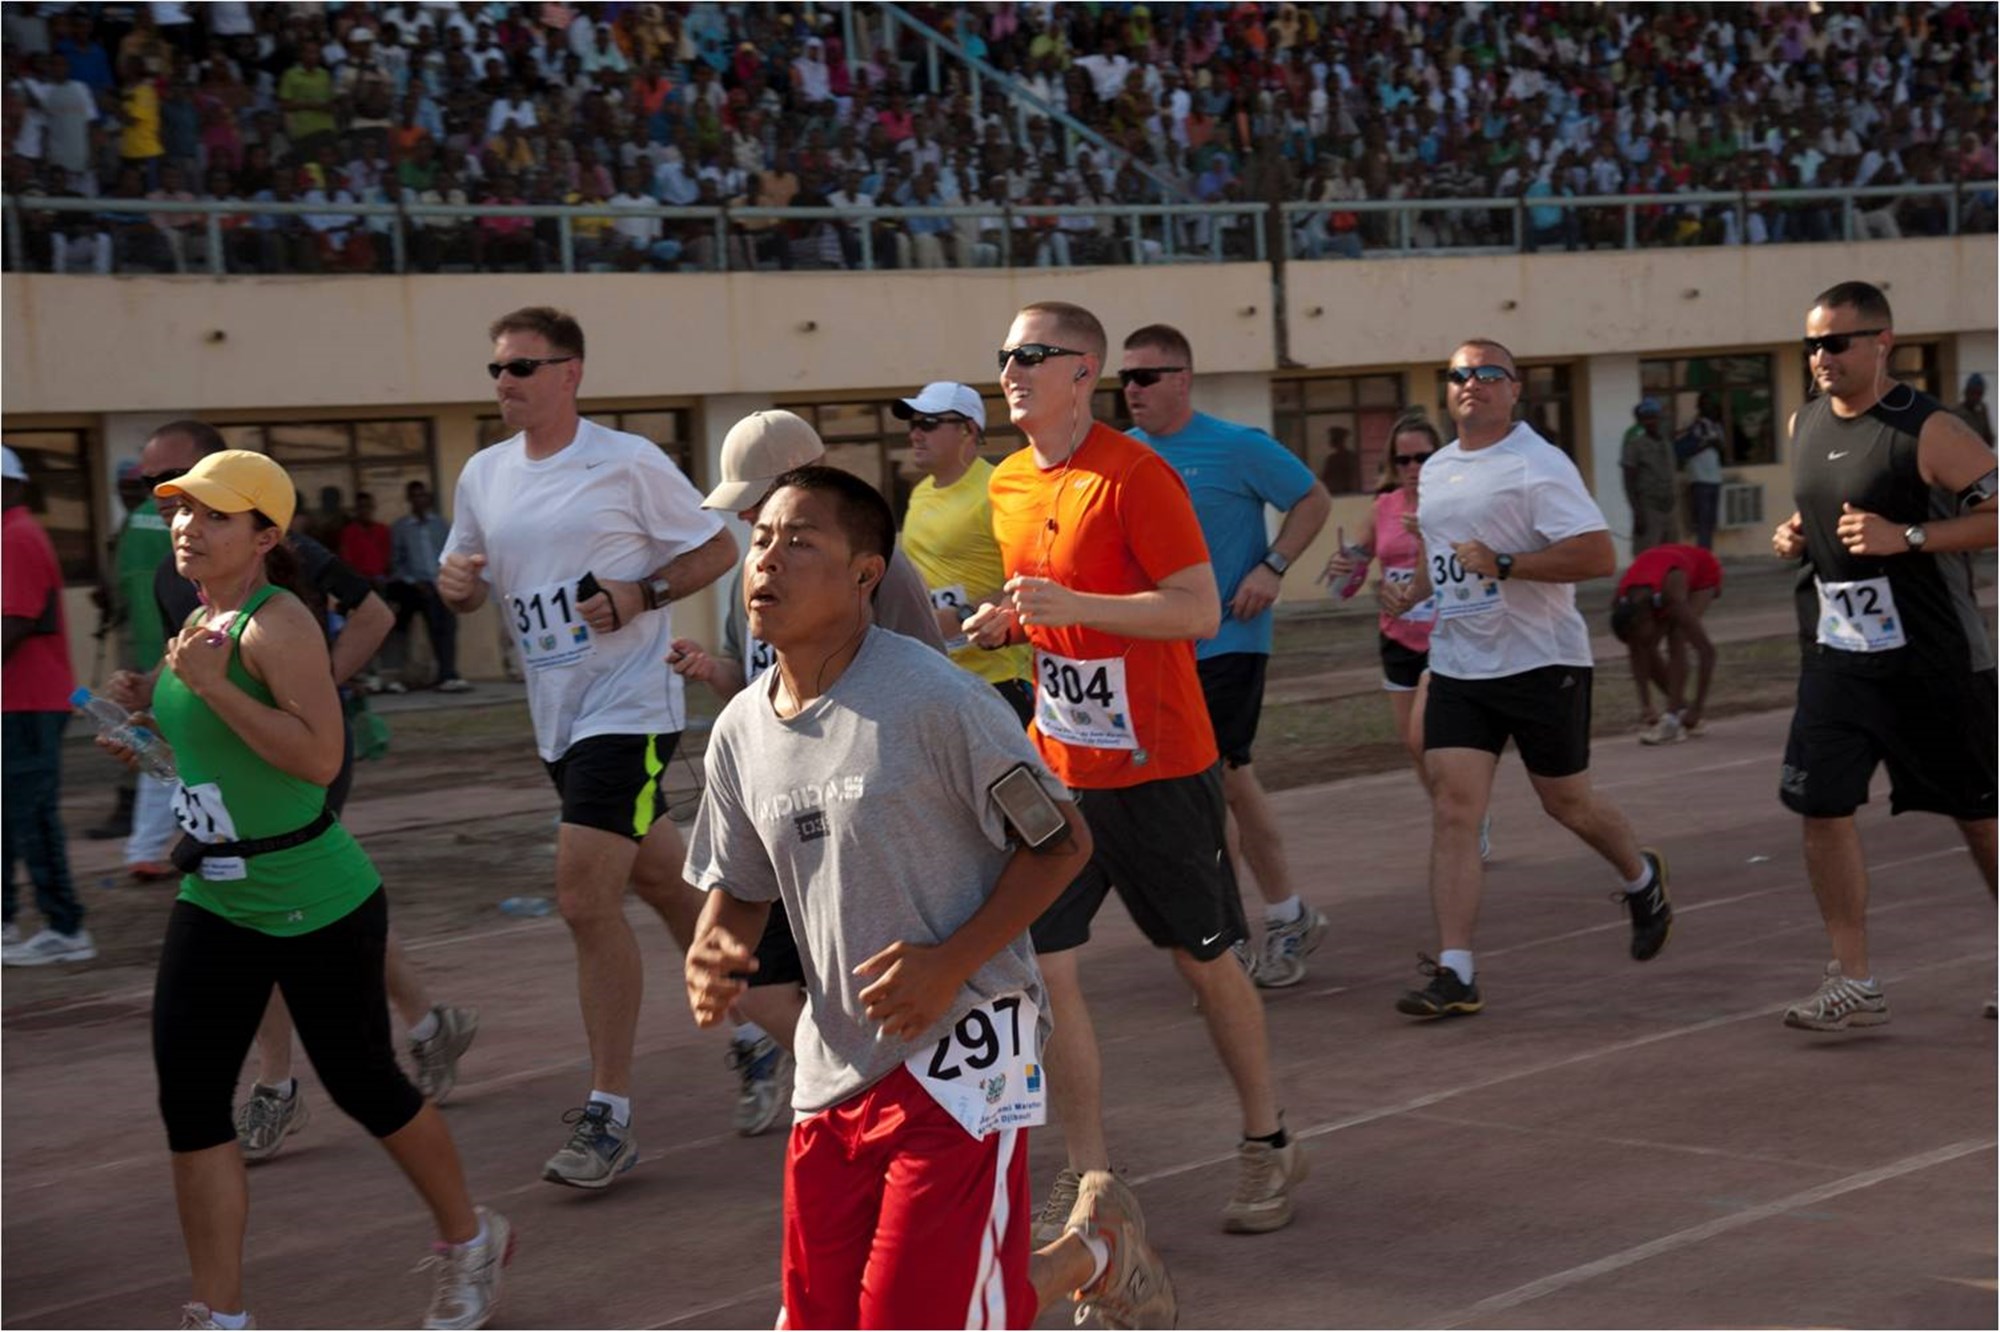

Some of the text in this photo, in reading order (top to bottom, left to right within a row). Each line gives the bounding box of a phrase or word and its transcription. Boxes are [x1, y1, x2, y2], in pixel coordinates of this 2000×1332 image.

[514, 587, 571, 633] 311
[1042, 658, 1113, 707] 304
[927, 997, 1021, 1080] 297
